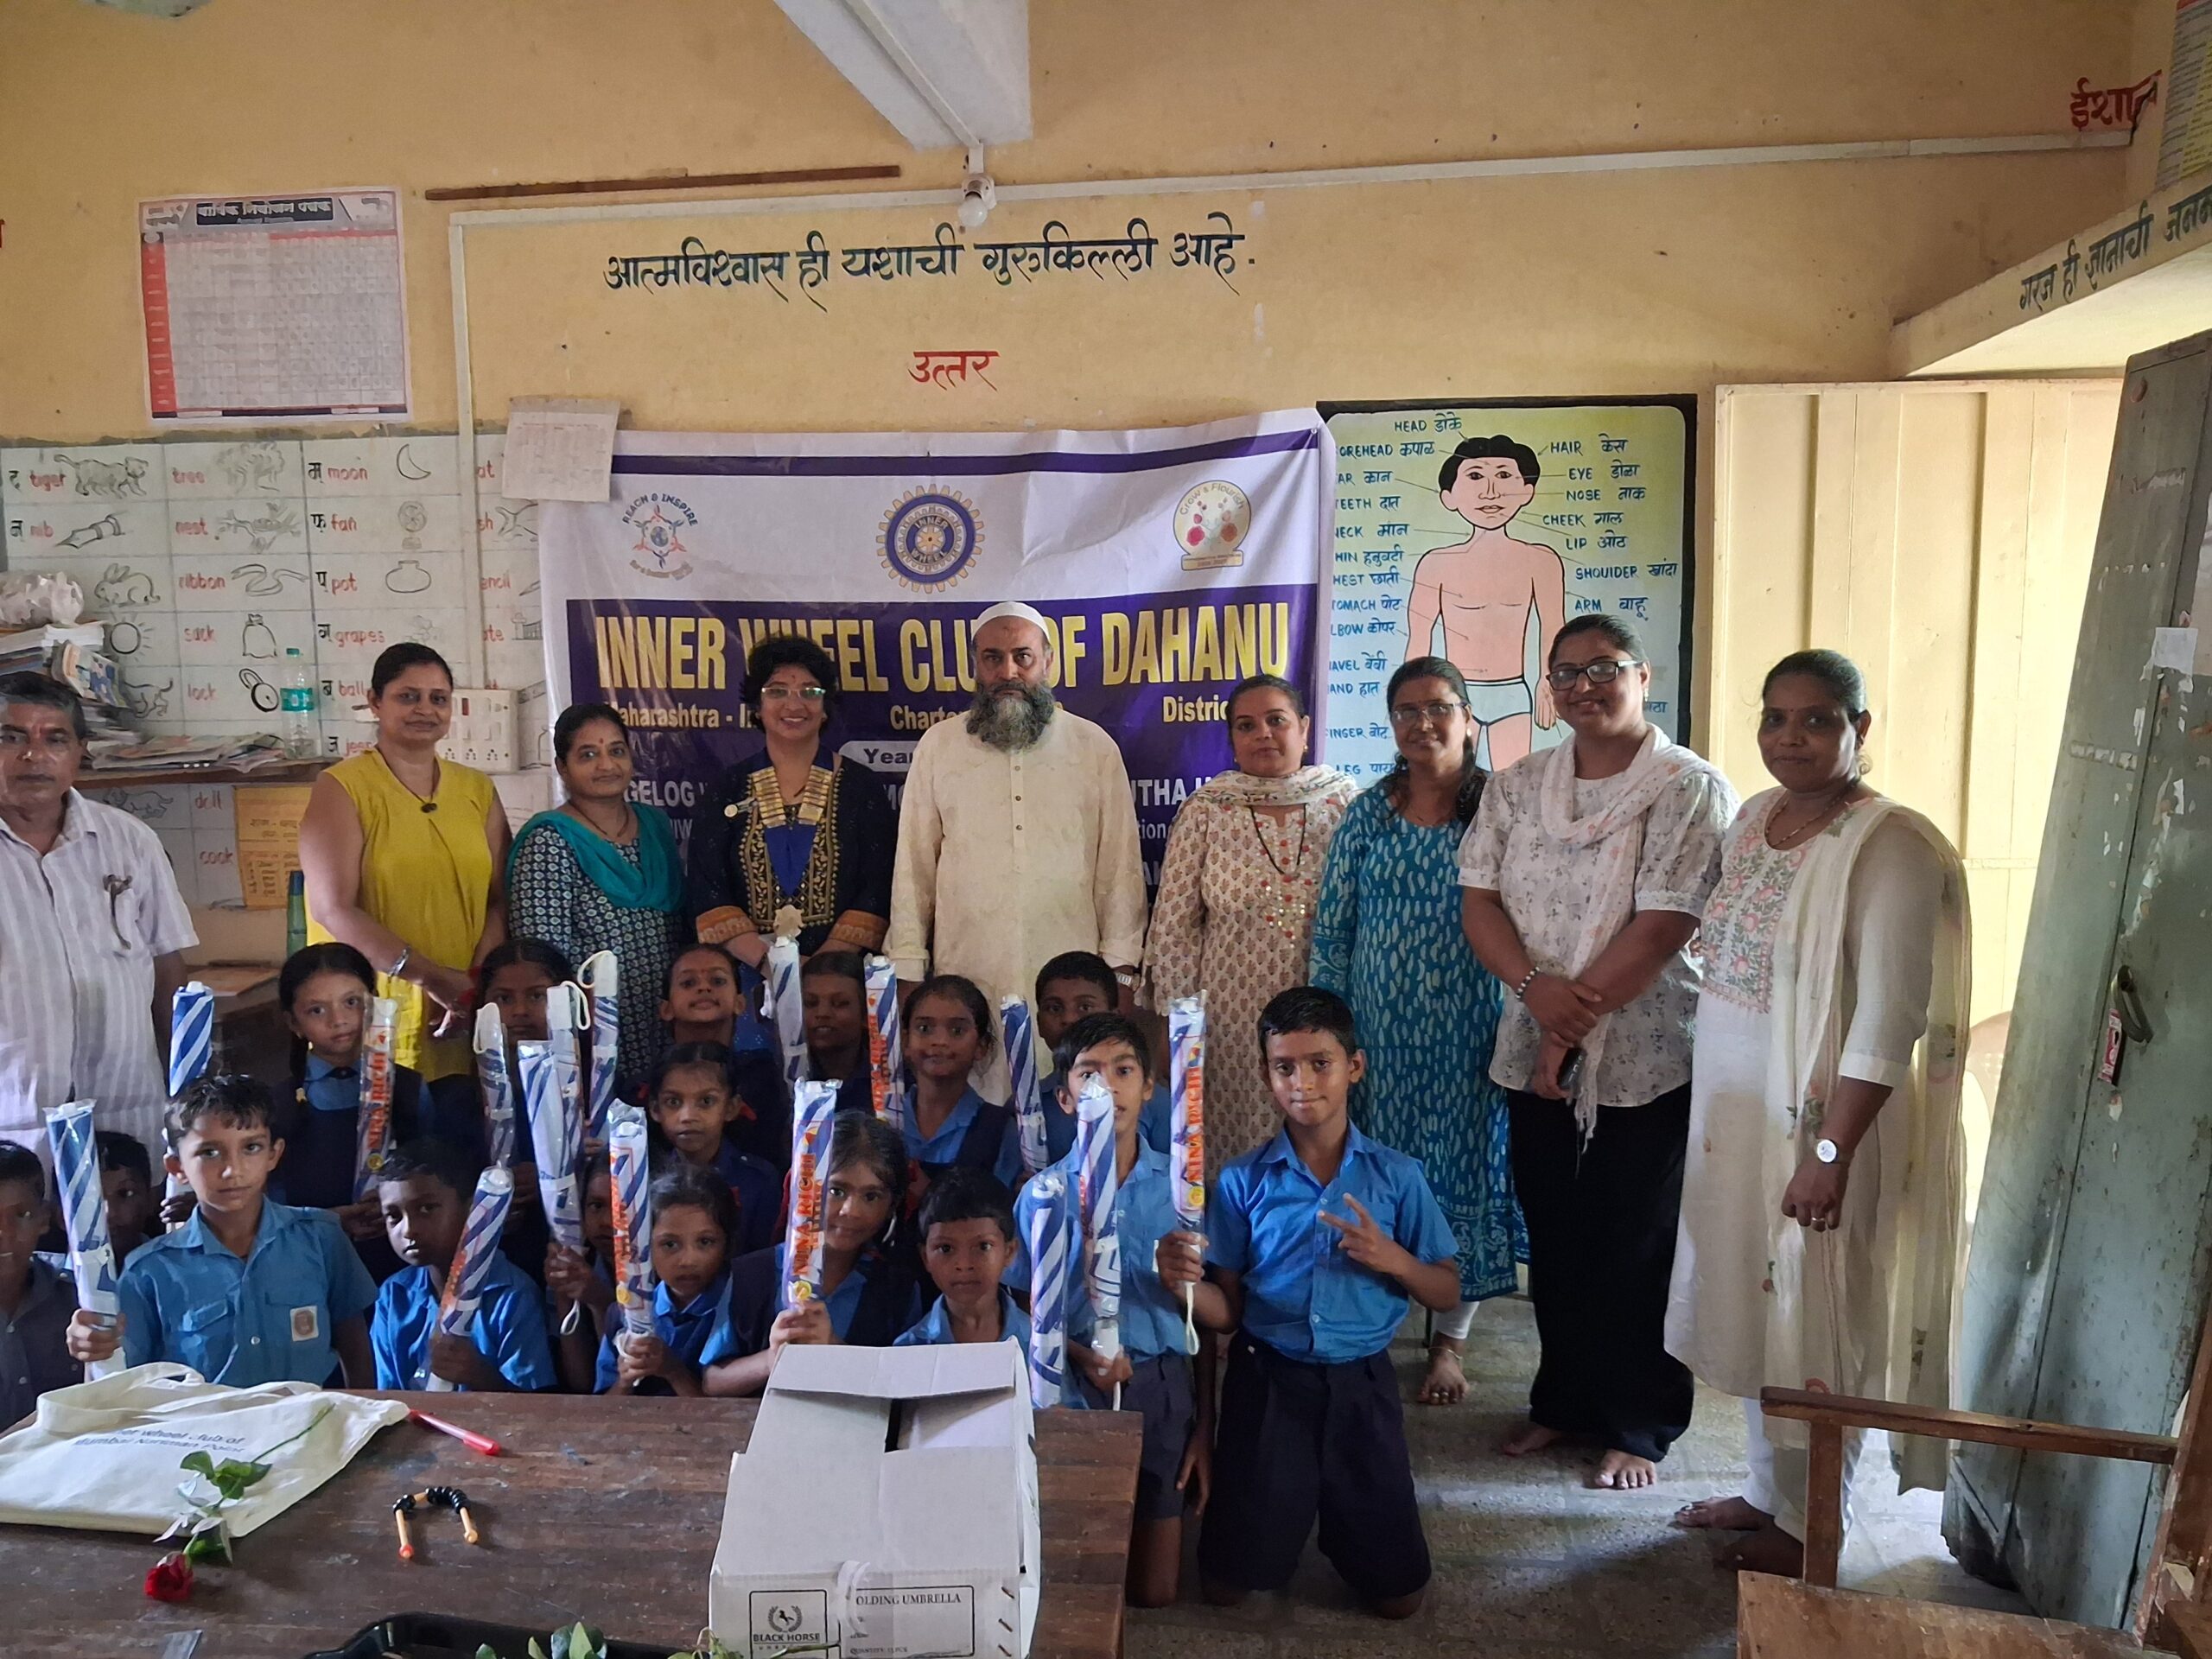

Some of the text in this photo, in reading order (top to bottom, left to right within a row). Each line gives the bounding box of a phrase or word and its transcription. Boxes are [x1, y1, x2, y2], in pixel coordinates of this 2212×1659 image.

[603, 236, 790, 302] आत्मविश्वास
[795, 230, 830, 313] ही
[841, 222, 965, 280] यशाची
[907, 351, 1001, 391] उत्तर
[1394, 420, 1427, 433] HEAD
[1338, 441, 1435, 460] OREHEAD कपाळ
[1550, 433, 1629, 456] HAIR केस
[327, 467, 368, 480] moon
[476, 461, 495, 478] at
[1338, 470, 1394, 486] AR कान
[1568, 467, 1592, 480] EYE
[1566, 486, 1646, 501] NOSE नाक
[622, 494, 648, 524] REACH
[662, 493, 698, 526] INSPIRE
[1379, 496, 1401, 512] दात
[331, 513, 357, 531] fan
[478, 512, 494, 531] sh
[914, 516, 949, 530] INNER
[1542, 512, 1624, 527] CHEEK गाल
[1566, 537, 1587, 550] LIP
[1335, 552, 1358, 563] HIN
[179, 572, 226, 590] ribbon
[331, 572, 358, 594] pot
[480, 569, 512, 590] encil
[1333, 574, 1365, 587] HEST
[1332, 594, 1402, 613] TOMACH पोट
[1574, 599, 1602, 613] ARM
[482, 624, 505, 642] ate
[1331, 617, 1396, 637] LBOW कोपर
[335, 627, 385, 647] grapes
[595, 615, 727, 690] INNER
[738, 618, 888, 692] WEEL
[899, 618, 979, 693] CLU
[1102, 602, 1288, 686] DAHANU
[339, 679, 365, 696] ball
[1329, 682, 1380, 698] AND हात
[610, 701, 720, 728] aharashtra
[1163, 694, 1229, 722] Distric
[890, 705, 959, 730] Charte
[1329, 728, 1368, 739] INGER
[623, 779, 696, 807] GELOG
[1186, 1134, 1202, 1181] NINA
[791, 1152, 817, 1275] NINA RICHI
[855, 1592, 962, 1605] OLDING UMBRELLA
[753, 1632, 821, 1642] BLACK HORSE
